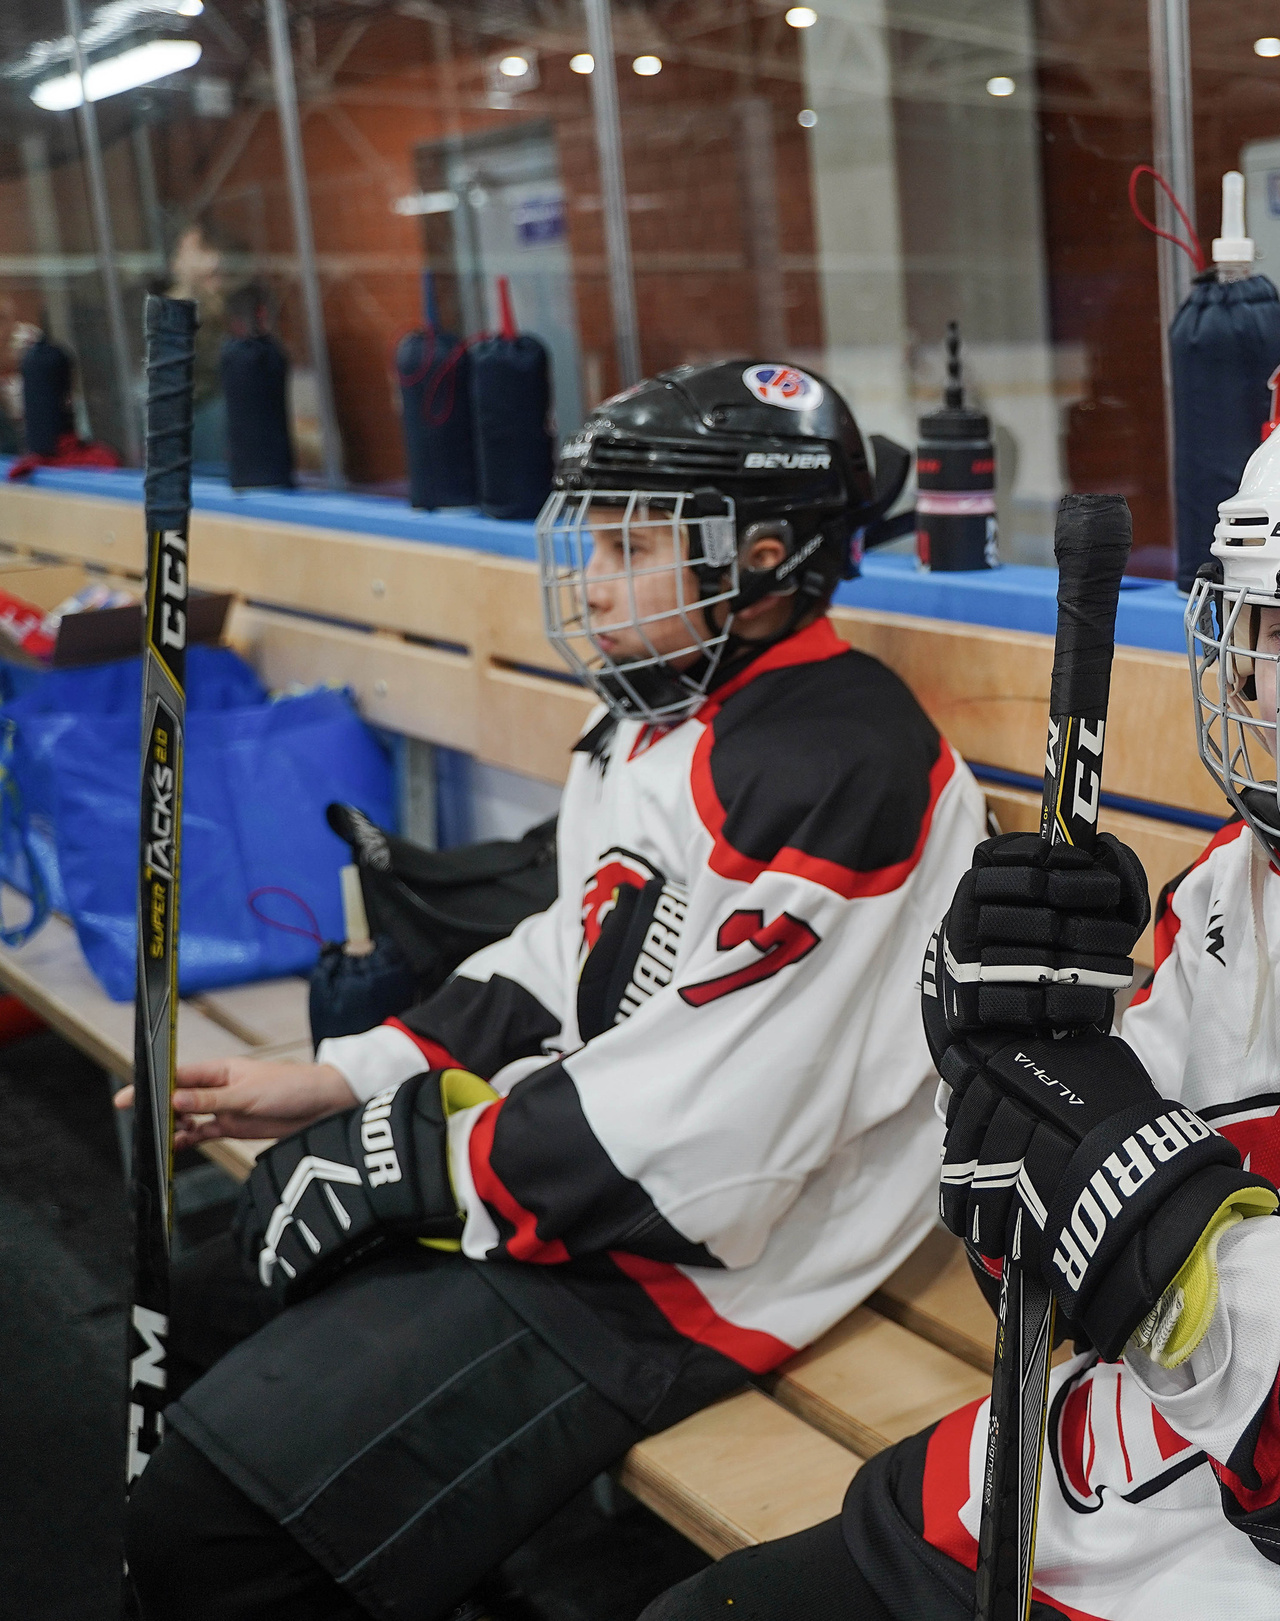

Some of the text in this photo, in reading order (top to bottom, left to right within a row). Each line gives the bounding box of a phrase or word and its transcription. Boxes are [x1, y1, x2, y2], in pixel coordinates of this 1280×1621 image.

[743, 452, 832, 470] BAUER
[775, 534, 825, 582] BAUER
[145, 763, 175, 881] TACKS
[150, 881, 166, 960] SUPER
[613, 880, 689, 1025] WARRI
[1013, 1051, 1085, 1106] ALPHA
[1052, 1108, 1226, 1293] ARRIOR
[984, 1435, 997, 1506] sigmatex
